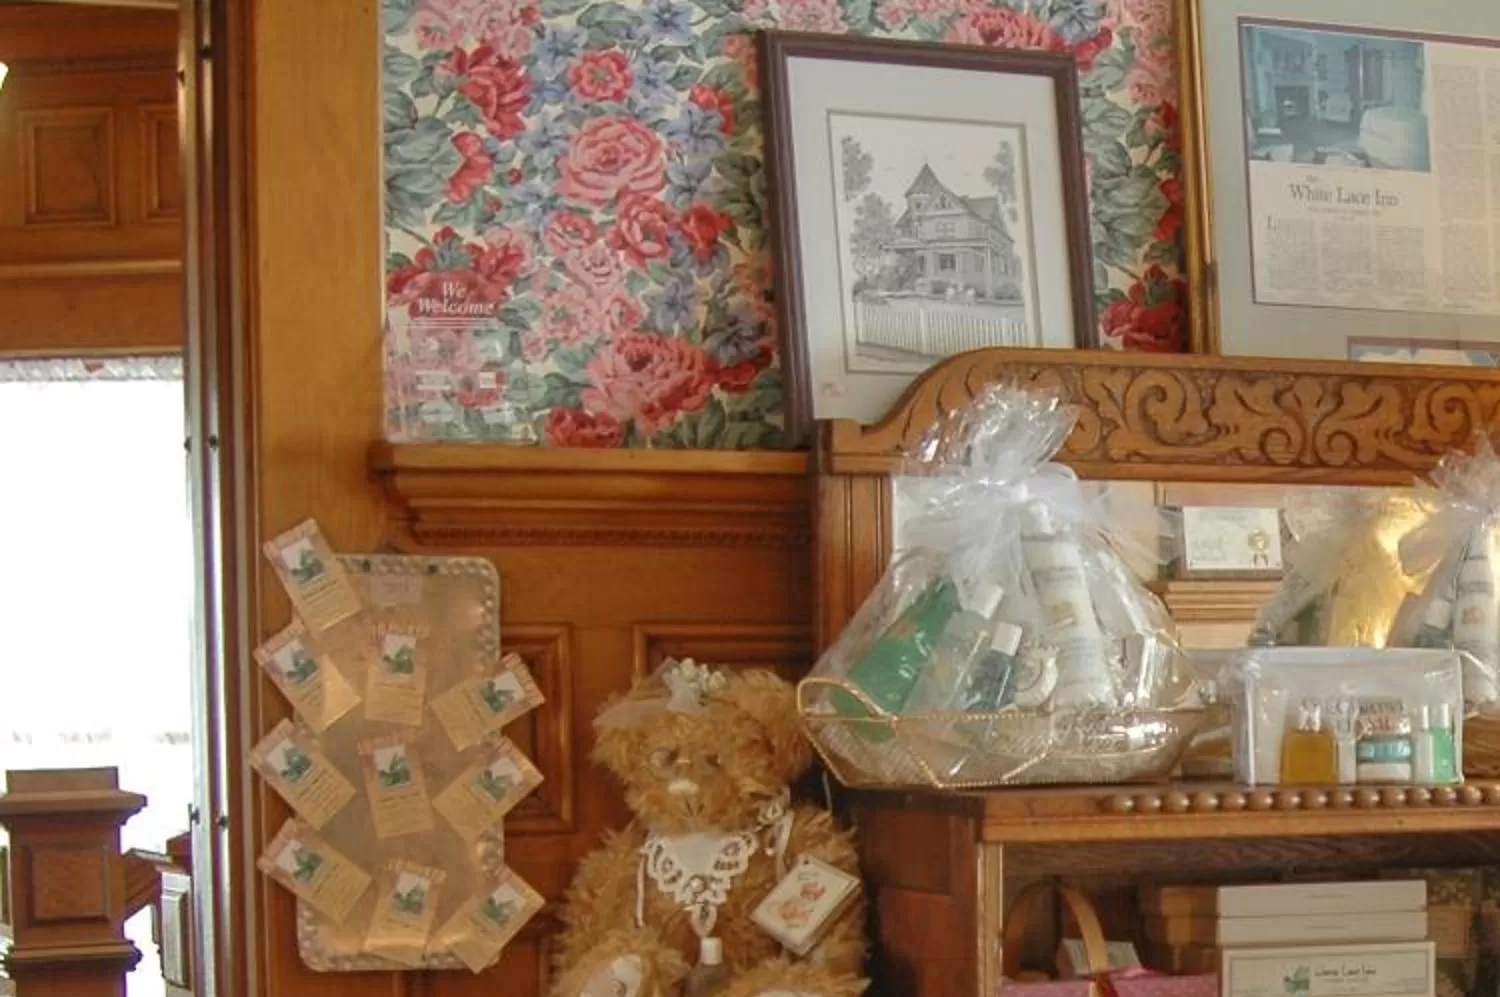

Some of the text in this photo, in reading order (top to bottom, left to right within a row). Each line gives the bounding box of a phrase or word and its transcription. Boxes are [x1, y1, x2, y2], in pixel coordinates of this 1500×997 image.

[1289, 183, 1400, 207] White Lace Inn
[443, 281, 467, 299] We
[418, 298, 496, 315] Welcome
